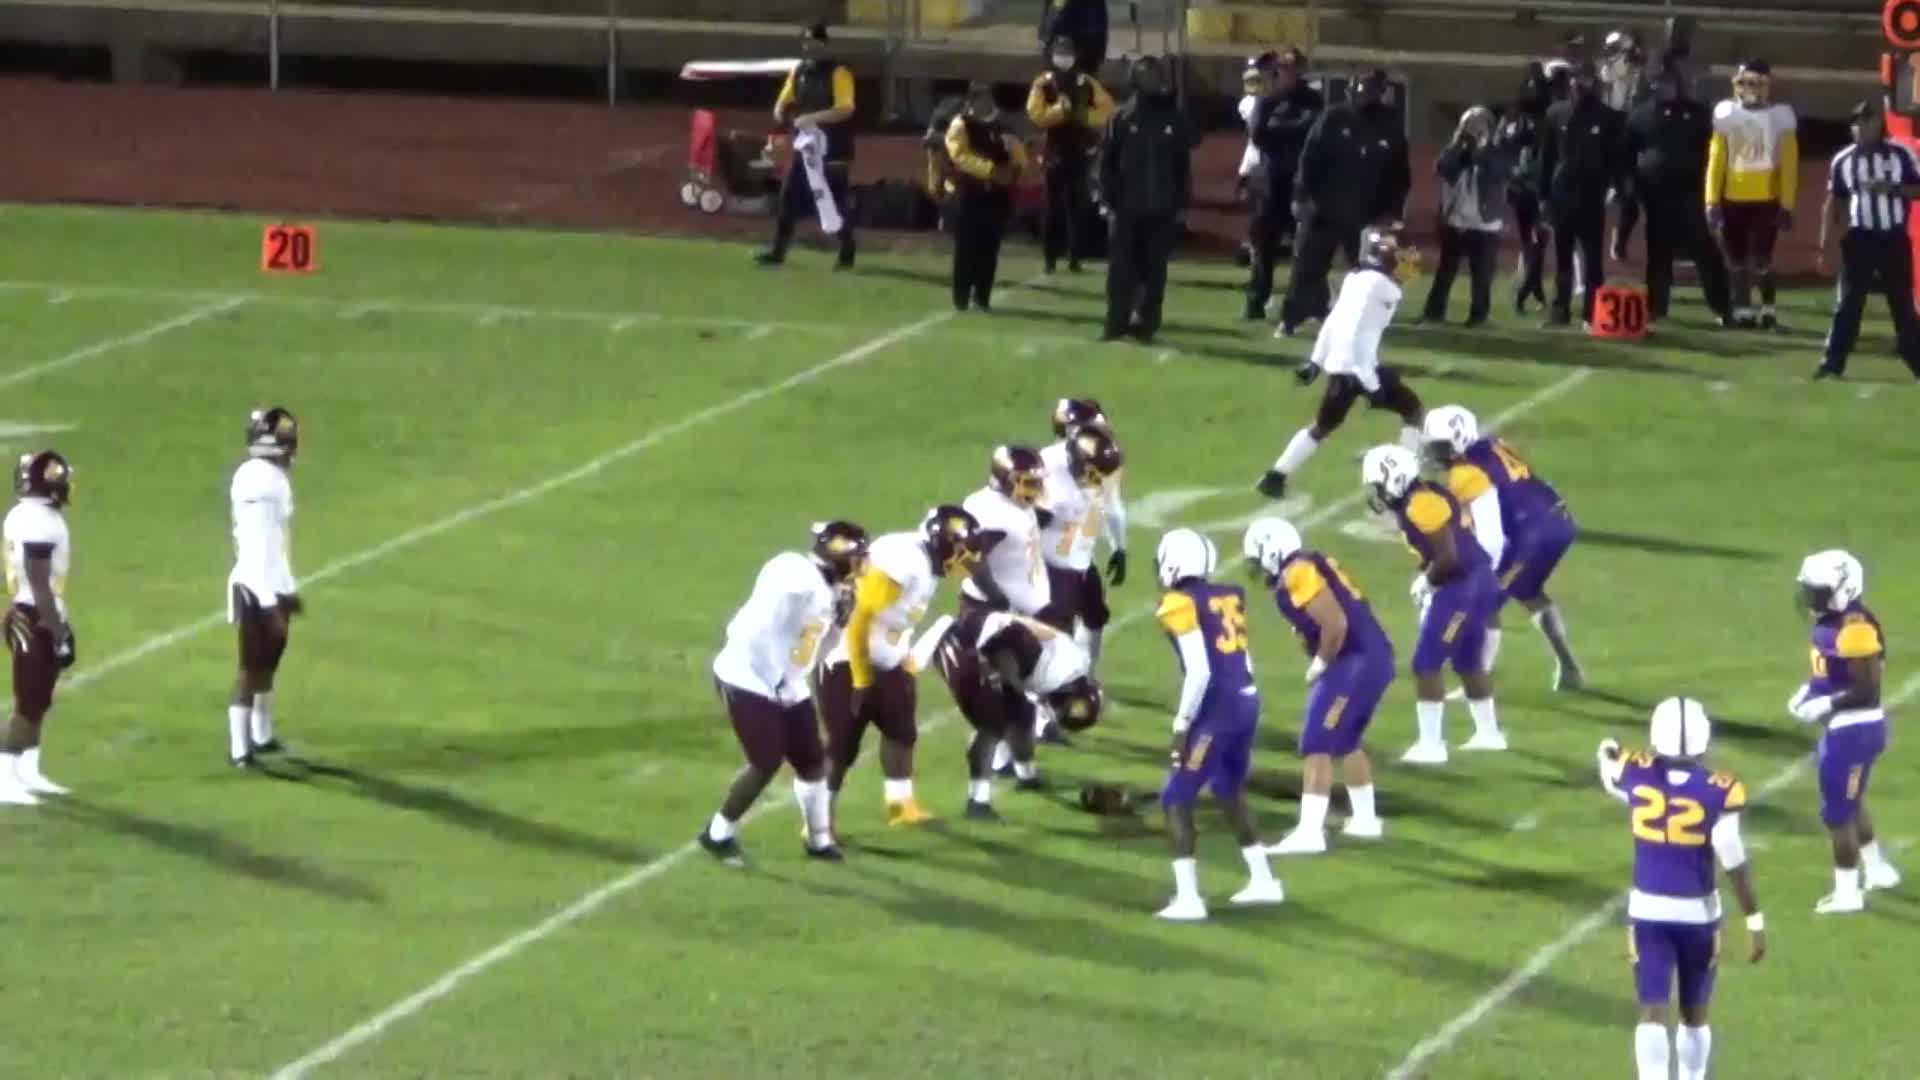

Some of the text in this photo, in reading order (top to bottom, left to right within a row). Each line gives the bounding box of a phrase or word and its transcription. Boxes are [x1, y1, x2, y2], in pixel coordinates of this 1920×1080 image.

[267, 229, 310, 269] 20
[1601, 293, 1643, 333] 30
[1631, 785, 1706, 846] 22
